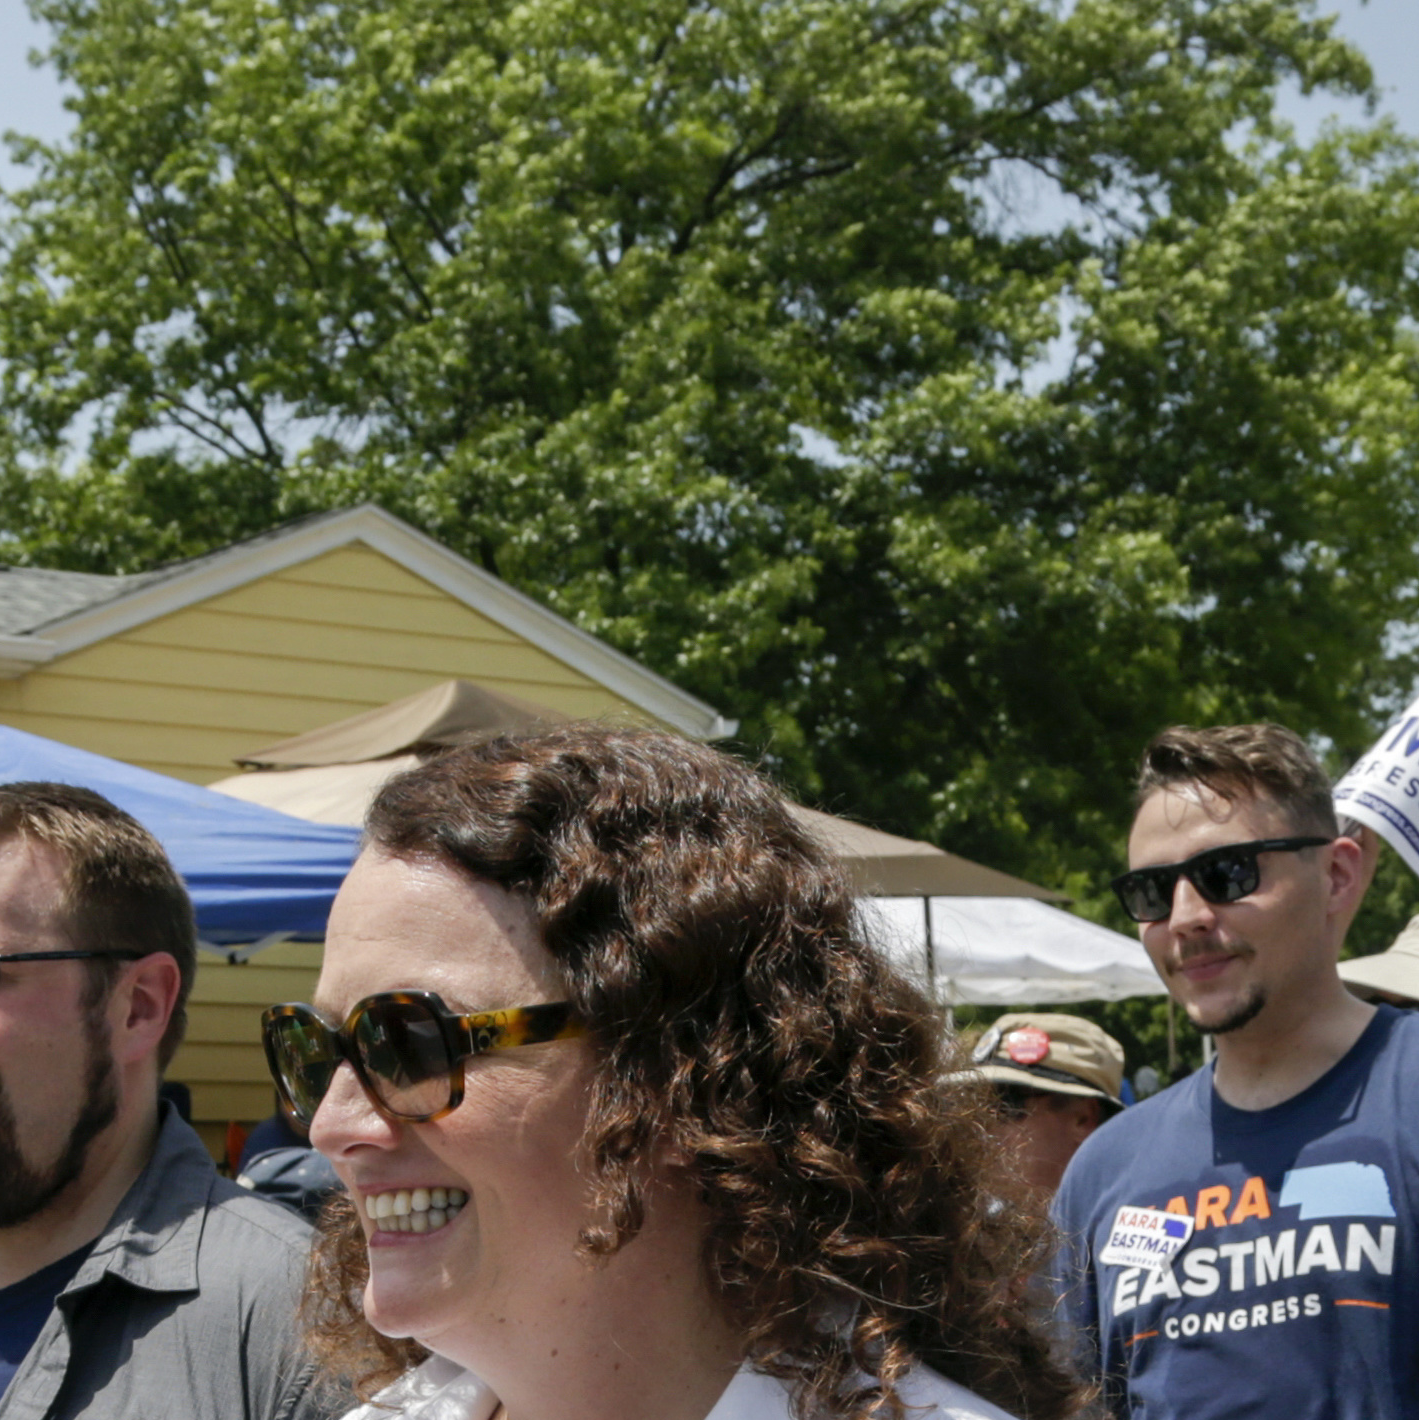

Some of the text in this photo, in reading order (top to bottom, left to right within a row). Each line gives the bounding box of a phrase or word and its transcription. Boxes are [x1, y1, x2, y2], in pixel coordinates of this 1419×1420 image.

[1118, 1211, 1159, 1231] KARA
[1113, 1225, 1397, 1317] EASTMAN
[1164, 1293, 1323, 1340] CONGRESS
